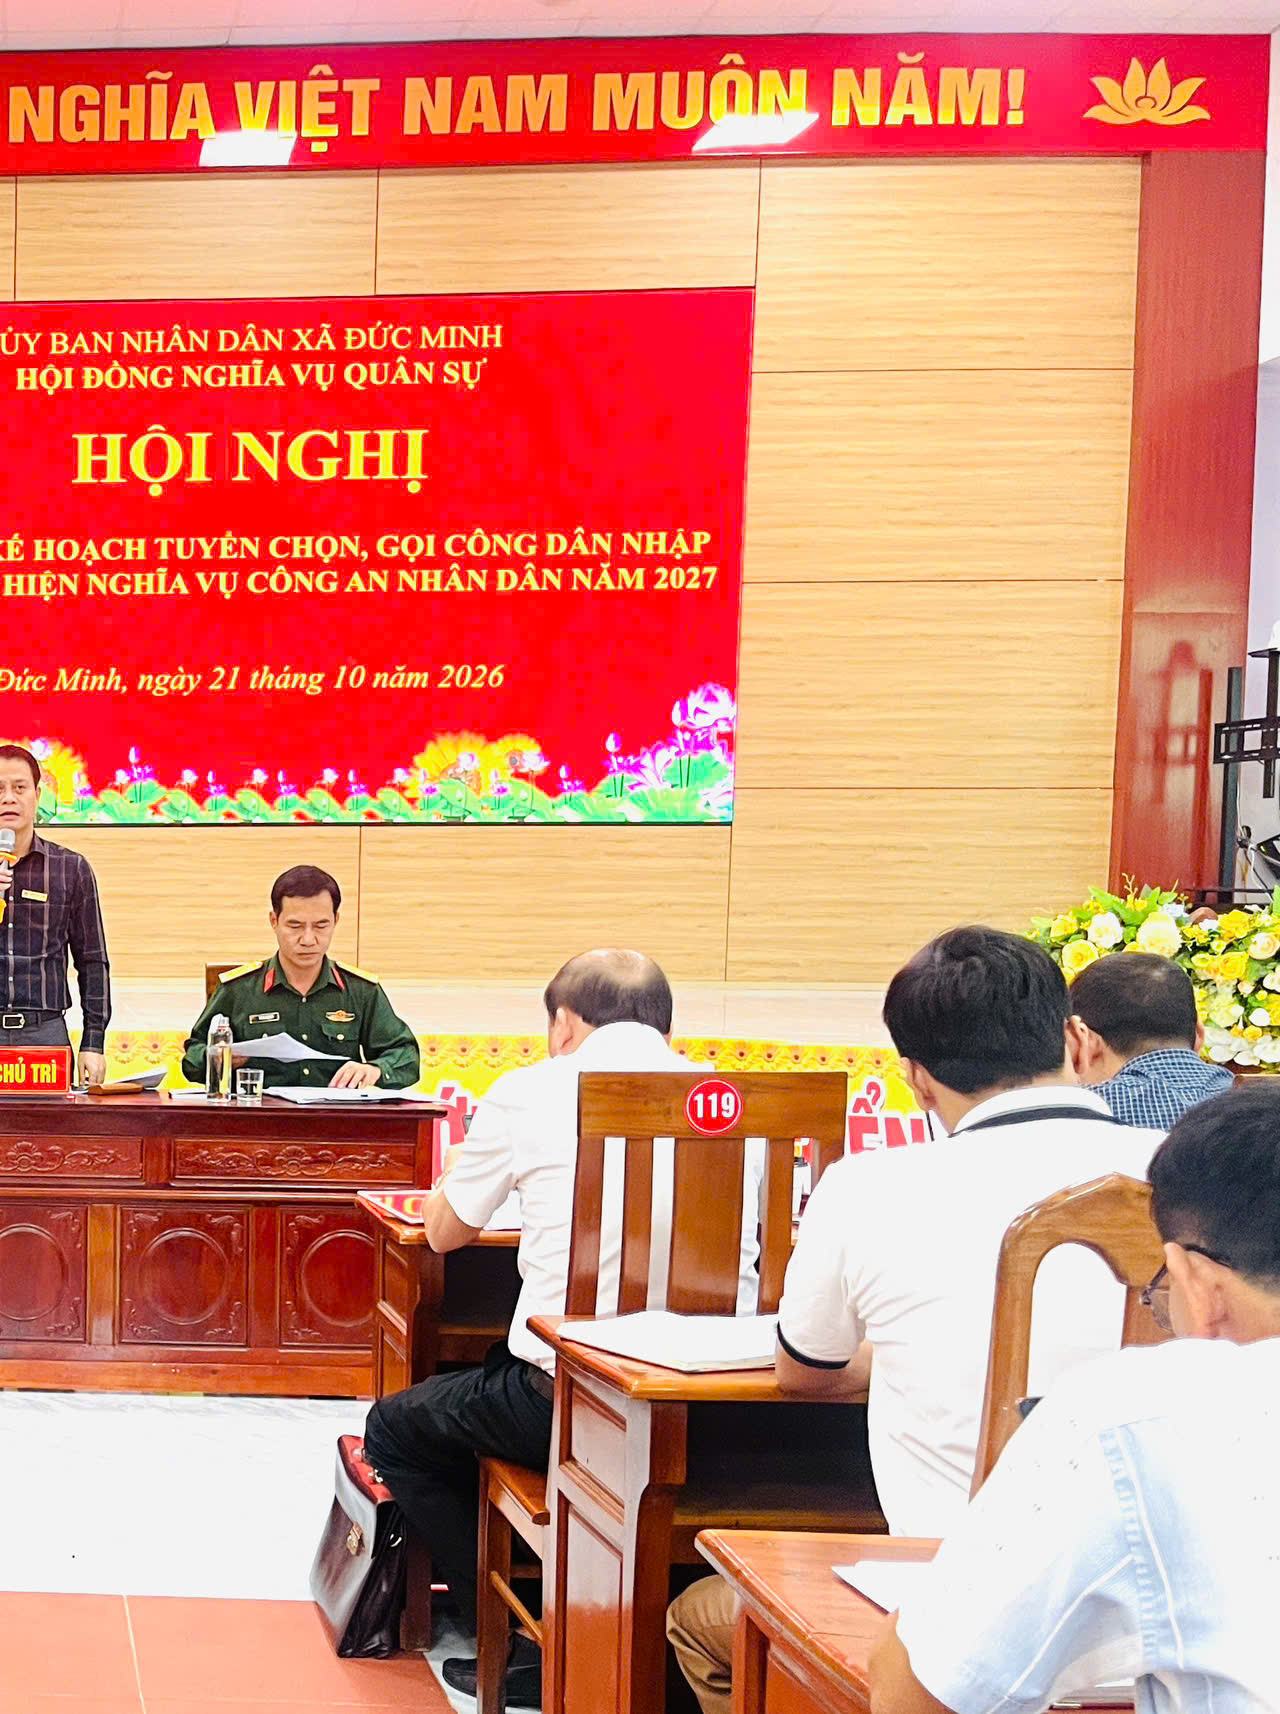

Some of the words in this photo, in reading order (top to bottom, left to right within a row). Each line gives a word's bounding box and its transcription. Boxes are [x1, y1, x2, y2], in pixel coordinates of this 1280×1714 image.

[9, 71, 216, 145] NGHĨA
[234, 64, 380, 152] VIỆT
[404, 75, 567, 134] NAM
[592, 53, 807, 131] MUÔN
[832, 52, 1024, 126] NĂM!
[0, 327, 41, 354] ỦY
[51, 332, 112, 354] BAN
[122, 325, 208, 353] NHÂN
[219, 324, 282, 351] DÂN
[293, 324, 335, 350] XÃ
[345, 322, 411, 349] ĐỨC
[420, 325, 502, 348] MINH
[17, 364, 72, 395] HỘI
[83, 360, 172, 388] ĐỒNG
[183, 360, 284, 387] NGHĨA
[292, 364, 334, 391] VỤ
[344, 357, 434, 389] QUÂN
[444, 358, 487, 389] SỰ
[72, 424, 212, 496] HỘI
[232, 430, 428, 493] NGHỊ
[34, 539, 145, 566] HOẠCH
[155, 532, 259, 559] TUYỂN
[269, 536, 368, 563] CHỌN,
[377, 535, 434, 562] GỌI
[445, 528, 536, 556] CÔNG
[547, 527, 612, 555] DÂN
[622, 529, 710, 559] NHẬP
[4, 571, 78, 601] HIỆN
[88, 567, 188, 595] NGHĨA
[196, 572, 237, 599] VỤ
[248, 566, 337, 593] CÔNG
[345, 571, 388, 592] AN
[398, 563, 487, 591] NHÂN
[497, 563, 562, 590] DÂN
[572, 563, 644, 590] NĂM
[654, 567, 717, 589] 2027
[54, 667, 127, 696] Minh,
[138, 667, 201, 696] ngày
[210, 667, 239, 689] 21
[250, 666, 324, 694] tháng
[335, 666, 365, 688] 10
[373, 666, 428, 688] năm
[438, 665, 504, 688] 2026
[31, 1060, 56, 1083] TRÌ
[694, 1092, 735, 1118] 119
